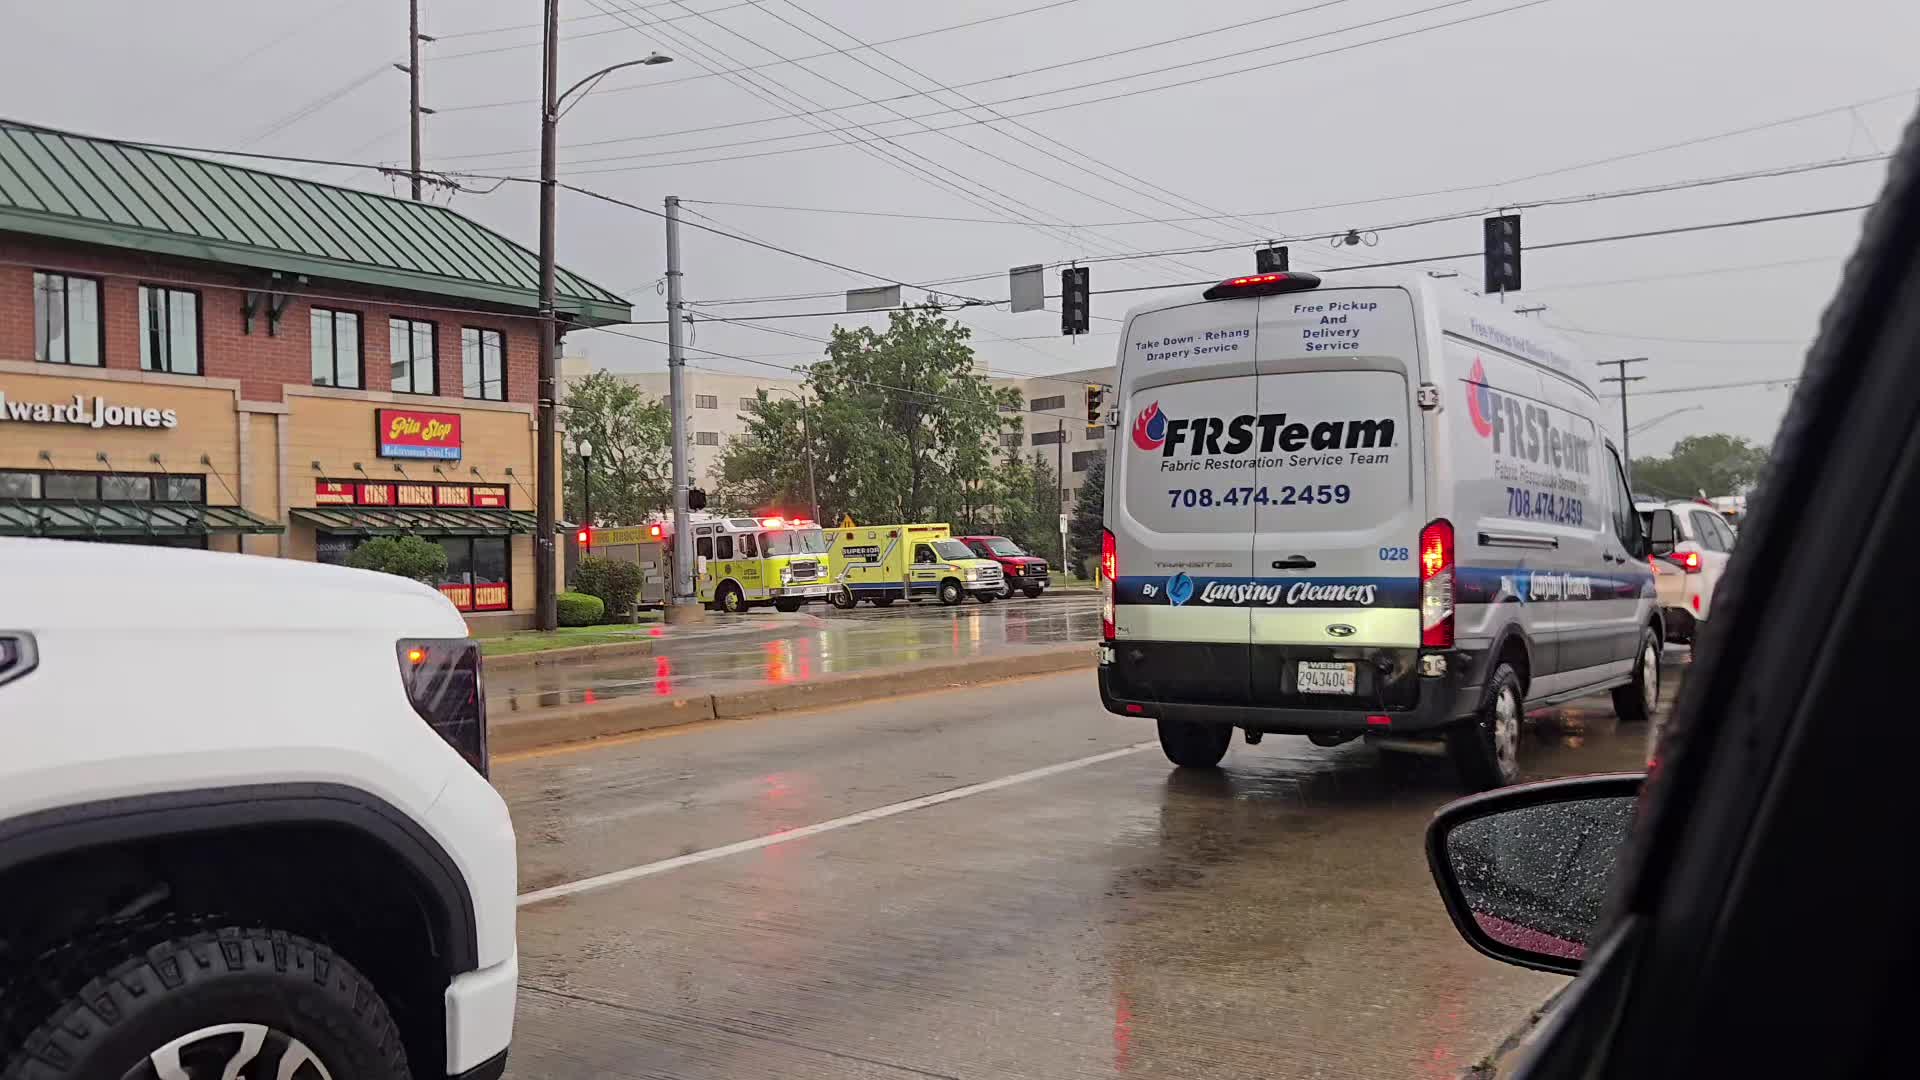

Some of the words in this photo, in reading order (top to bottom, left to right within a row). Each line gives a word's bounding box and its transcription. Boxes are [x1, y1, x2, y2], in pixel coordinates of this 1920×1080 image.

[1294, 303, 1324, 314] Free
[1329, 301, 1377, 312] Pickup
[1320, 314, 1347, 325] And
[1135, 339, 1160, 351] Take
[1163, 335, 1194, 346] Down
[1205, 328, 1250, 342] Rehang
[1303, 327, 1360, 339] Delivery
[1146, 349, 1190, 362] Drapery
[1193, 343, 1239, 355] Service
[1305, 340, 1359, 351] Service
[90, 396, 177, 428] Jones
[389, 416, 421, 440] Pita
[422, 419, 452, 441] Stop
[1162, 413, 1395, 457] FRSTeam
[1488, 391, 1590, 476] FRSTeam
[1160, 459, 1200, 472] Fabric
[1204, 457, 1283, 471] Restoration
[1289, 454, 1343, 467] Service
[1349, 453, 1389, 465] Team
[1168, 484, 1351, 508] 708.474.2459
[1506, 487, 1583, 526] 708.474.2459
[843, 547, 880, 555] SUPERIOR
[1379, 547, 1408, 561] 028
[476, 587, 506, 605] CATERING
[1143, 583, 1159, 597] By
[1200, 581, 1282, 604] Lansing
[1286, 582, 1377, 605] Cleaners
[1299, 672, 1345, 688] 2943404
